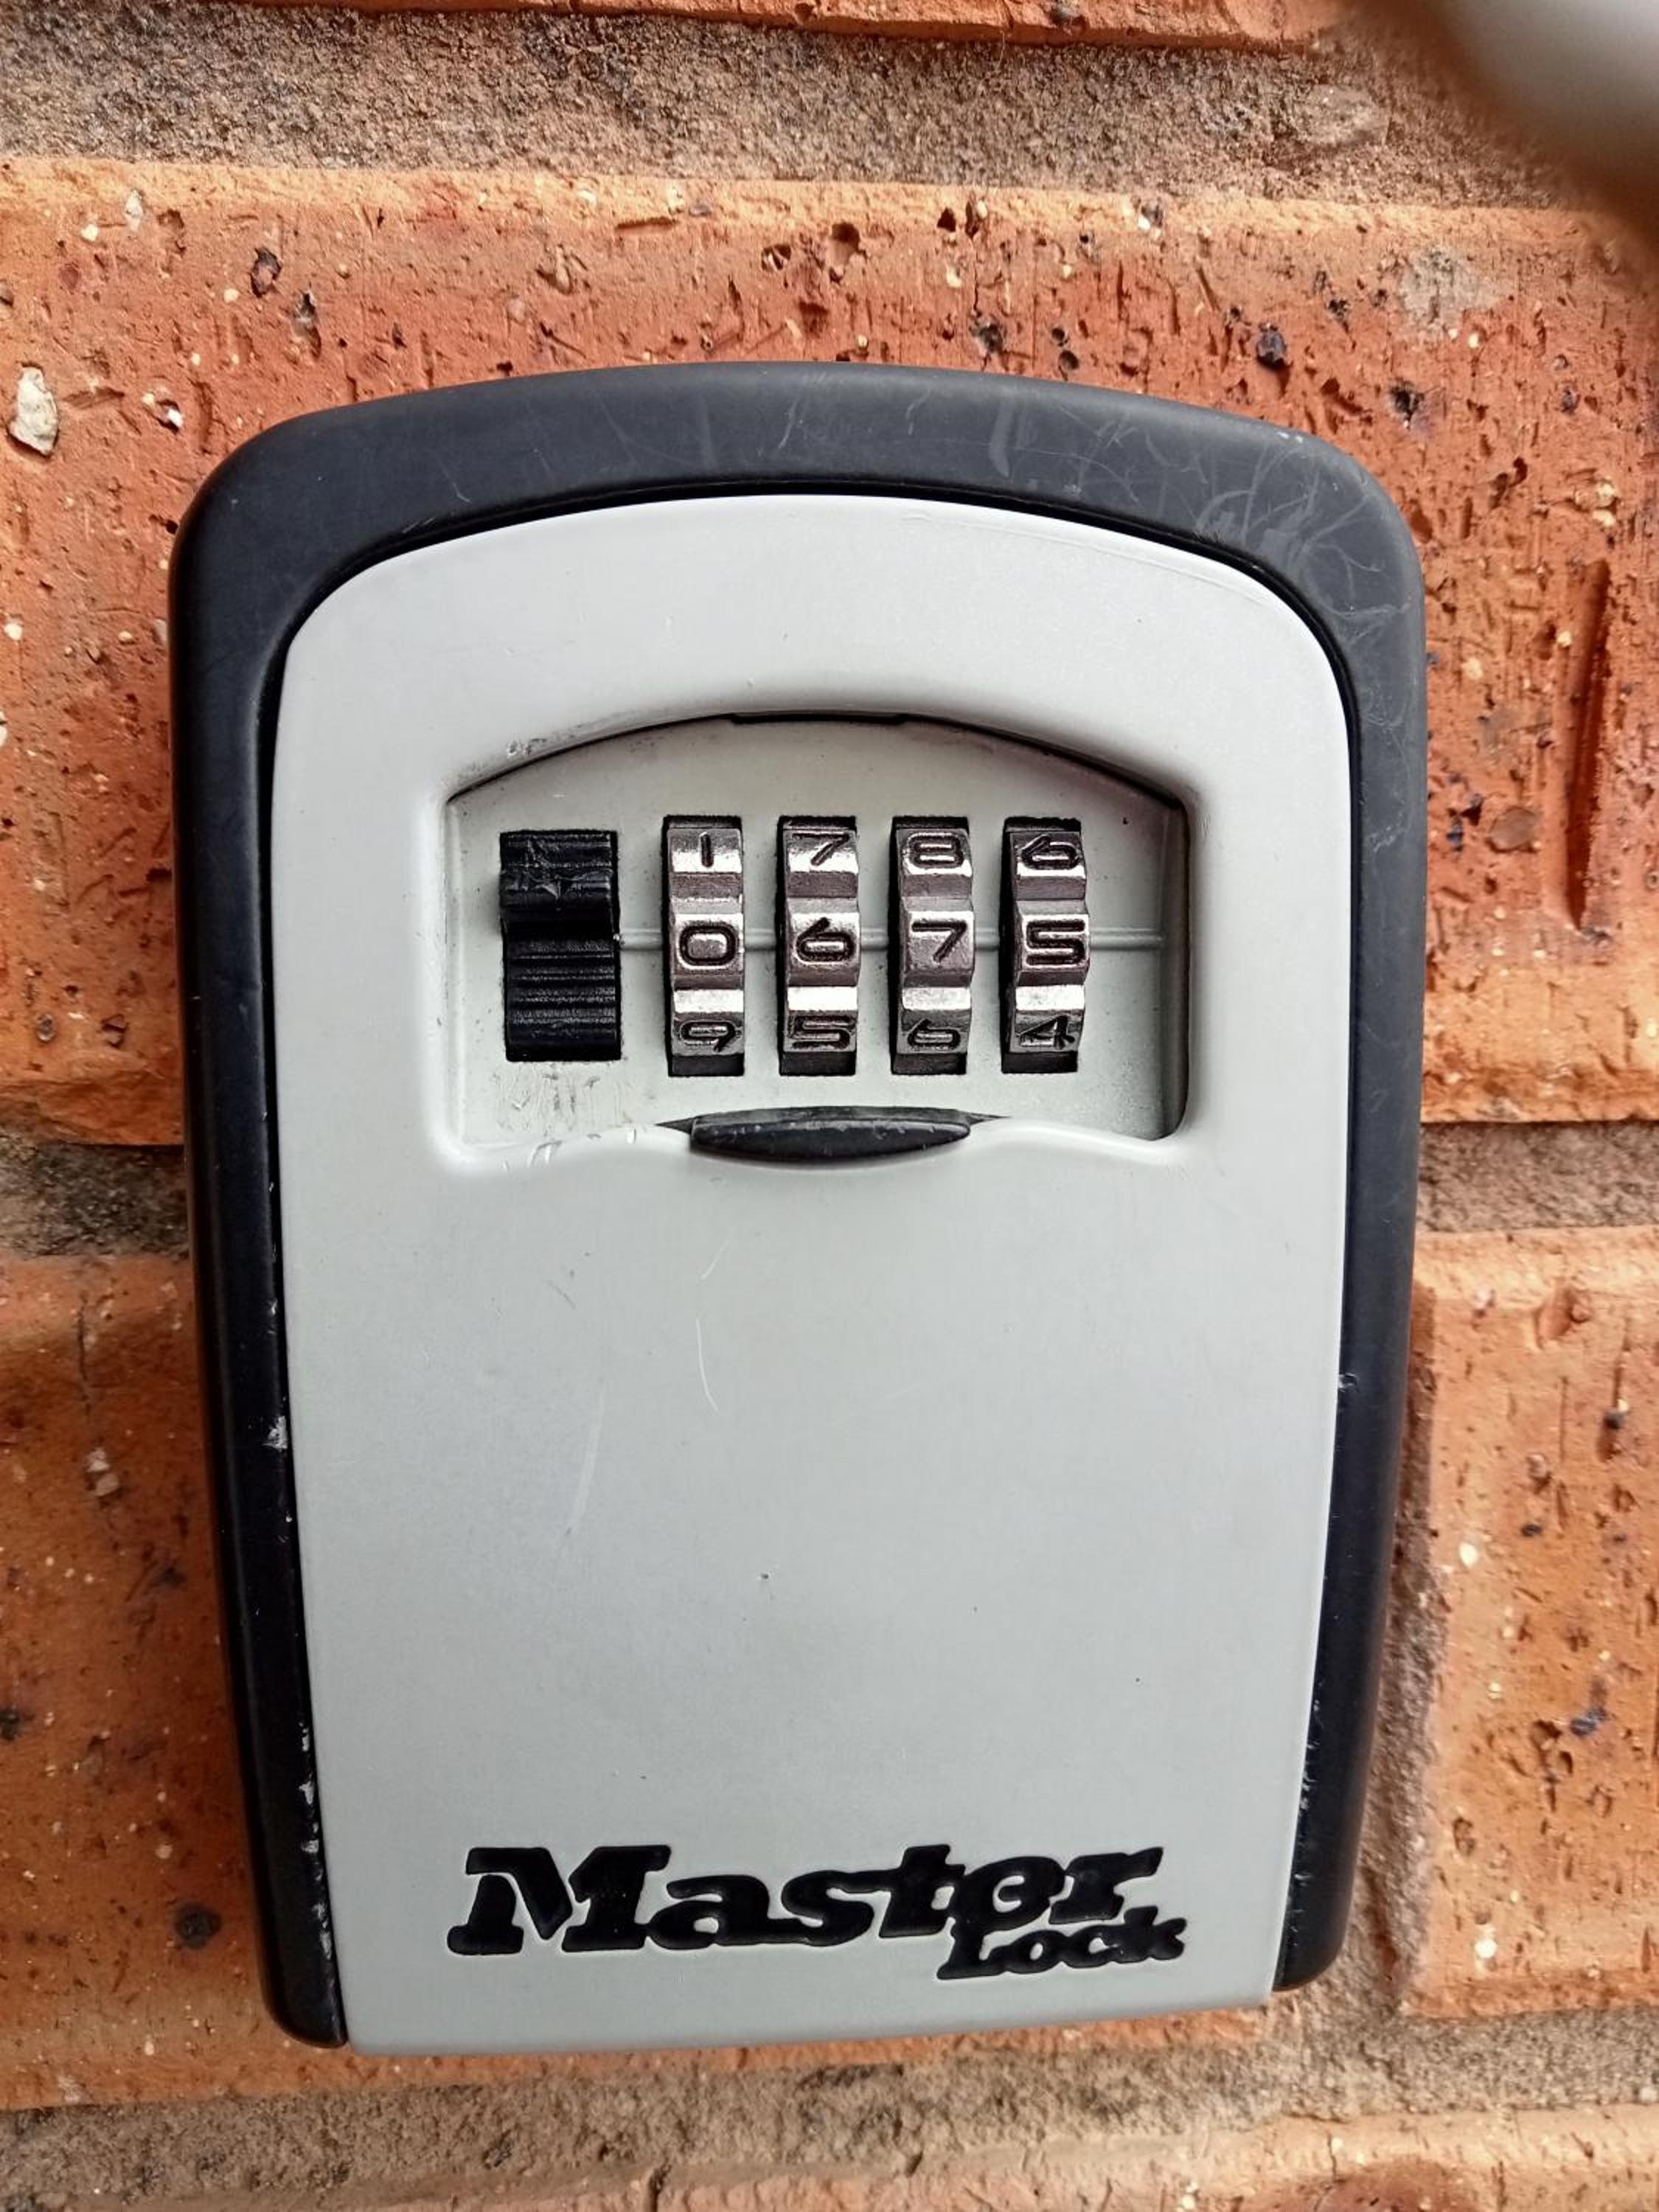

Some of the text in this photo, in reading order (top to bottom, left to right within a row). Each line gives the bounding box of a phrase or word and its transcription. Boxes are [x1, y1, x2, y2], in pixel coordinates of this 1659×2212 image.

[792, 832, 850, 866] 7
[1021, 835, 1079, 870] 6
[679, 917, 1086, 966] 0 6 7 5
[681, 1015, 1075, 1053] 9 5 6 4
[446, 1844, 1164, 1955] Master
[936, 1905, 1188, 1980] Lock
